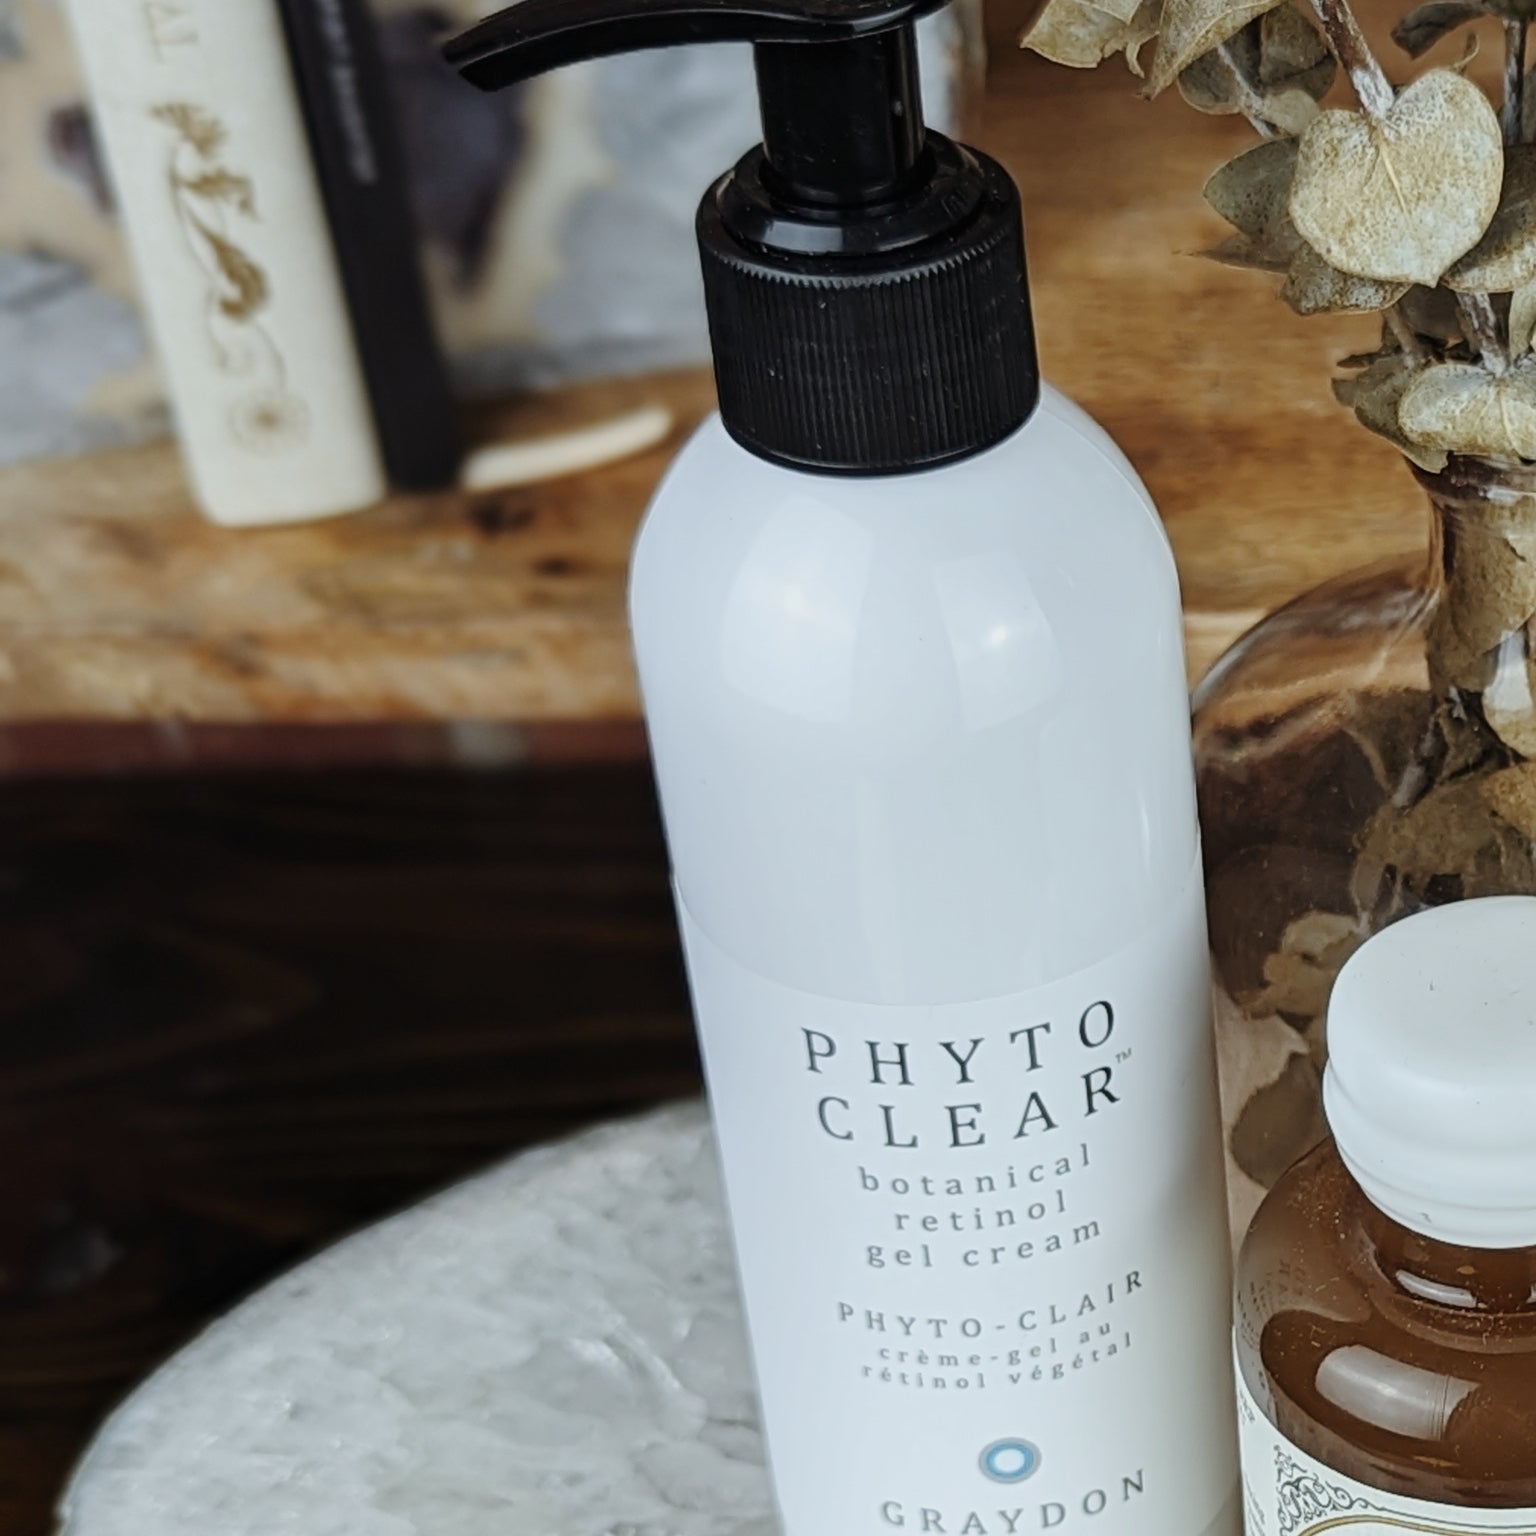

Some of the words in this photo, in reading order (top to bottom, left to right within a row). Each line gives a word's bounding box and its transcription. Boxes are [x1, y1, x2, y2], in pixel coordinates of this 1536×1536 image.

[801, 1000, 1115, 1086] PHYTO
[858, 1143, 1090, 1196] botanical
[895, 1190, 1066, 1232] retinol
[866, 1244, 933, 1269] gel
[962, 1219, 1101, 1267] cream
[838, 1270, 1143, 1339] PHYTO-CLAIR
[861, 1364, 986, 1390] rétinol
[1008, 1331, 1131, 1385] végétal
[879, 1337, 1057, 1367] crème-gel
[1079, 1321, 1111, 1345] au
[880, 1469, 1146, 1536] GRAYDON
